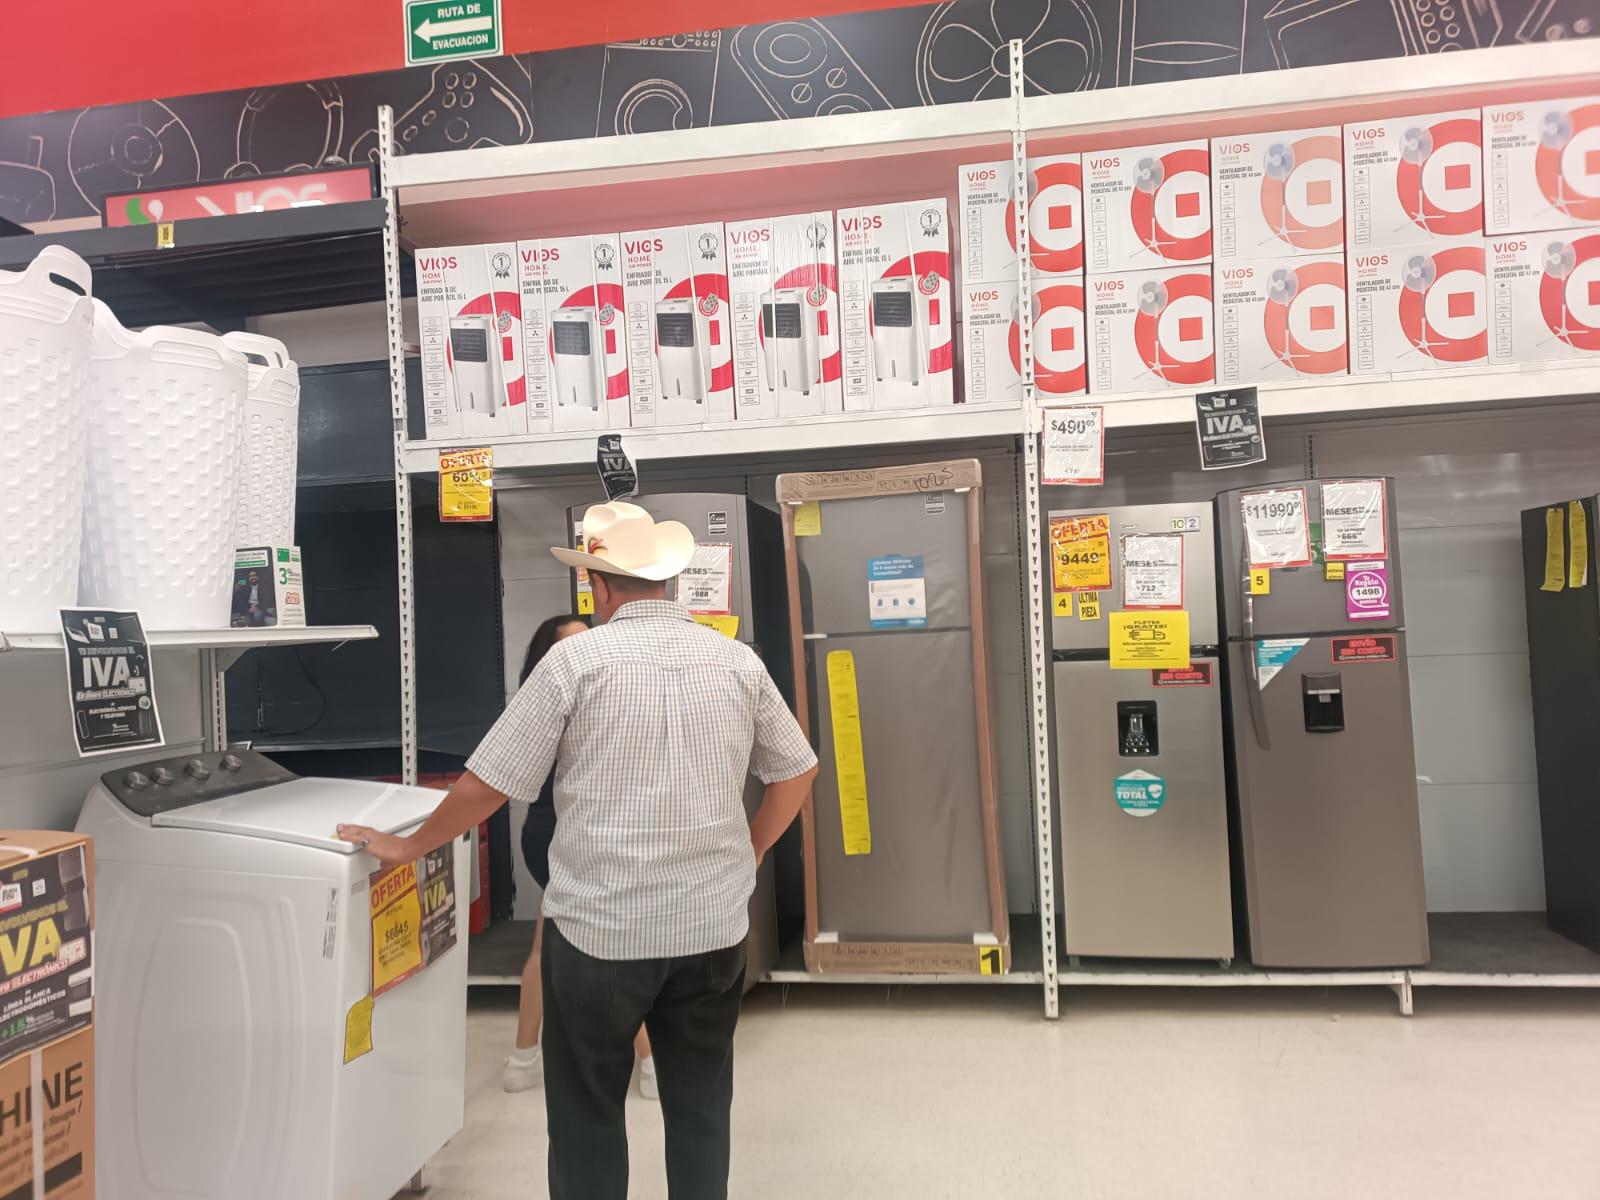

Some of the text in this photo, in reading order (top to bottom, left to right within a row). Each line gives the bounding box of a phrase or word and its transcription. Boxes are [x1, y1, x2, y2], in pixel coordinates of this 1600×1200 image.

[438, 3, 482, 19] RUTA DE
[1491, 111, 1525, 124] VIOS
[1352, 127, 1386, 141] VIOS
[1219, 143, 1251, 155] VIOS
[1090, 157, 1120, 170] VIOS
[967, 170, 997, 182] VIOS
[1219, 166, 1246, 176] VENTILADOR
[1219, 173, 1241, 181] PEDESTAL
[841, 215, 882, 232] VIOS
[730, 228, 771, 245] VIOS
[624, 239, 663, 254] VIOS
[1493, 240, 1528, 254] VIOS
[521, 248, 560, 263] VIOS
[628, 255, 652, 264] HOME
[1355, 255, 1389, 267] VIOS
[418, 256, 458, 271] VIOS
[422, 272, 445, 281] HOM
[1222, 267, 1254, 280] VIOS
[522, 279, 554, 287] ENFRIAOR
[1094, 280, 1125, 293] VIOS
[970, 290, 999, 302] VIOS
[1206, 414, 1244, 435] IVA
[453, 471, 481, 483] 60%
[1325, 507, 1359, 516] MESES
[1051, 518, 1108, 539] OFERTA
[1189, 518, 1197, 528] 2
[1126, 559, 1158, 568] MESES
[279, 567, 288, 585] 3
[1256, 576, 1264, 586] 5
[1356, 588, 1381, 597] 1498
[582, 598, 588, 607] 1
[1058, 597, 1067, 609] 4
[1081, 606, 1098, 619] PIEZA
[83, 656, 131, 689] IVA
[1117, 791, 1148, 800] TOTAL
[371, 864, 415, 909] OFERTA
[424, 879, 447, 915] IVA
[982, 949, 1001, 975] 1
[24, 987, 51, 1004] BLANCA
